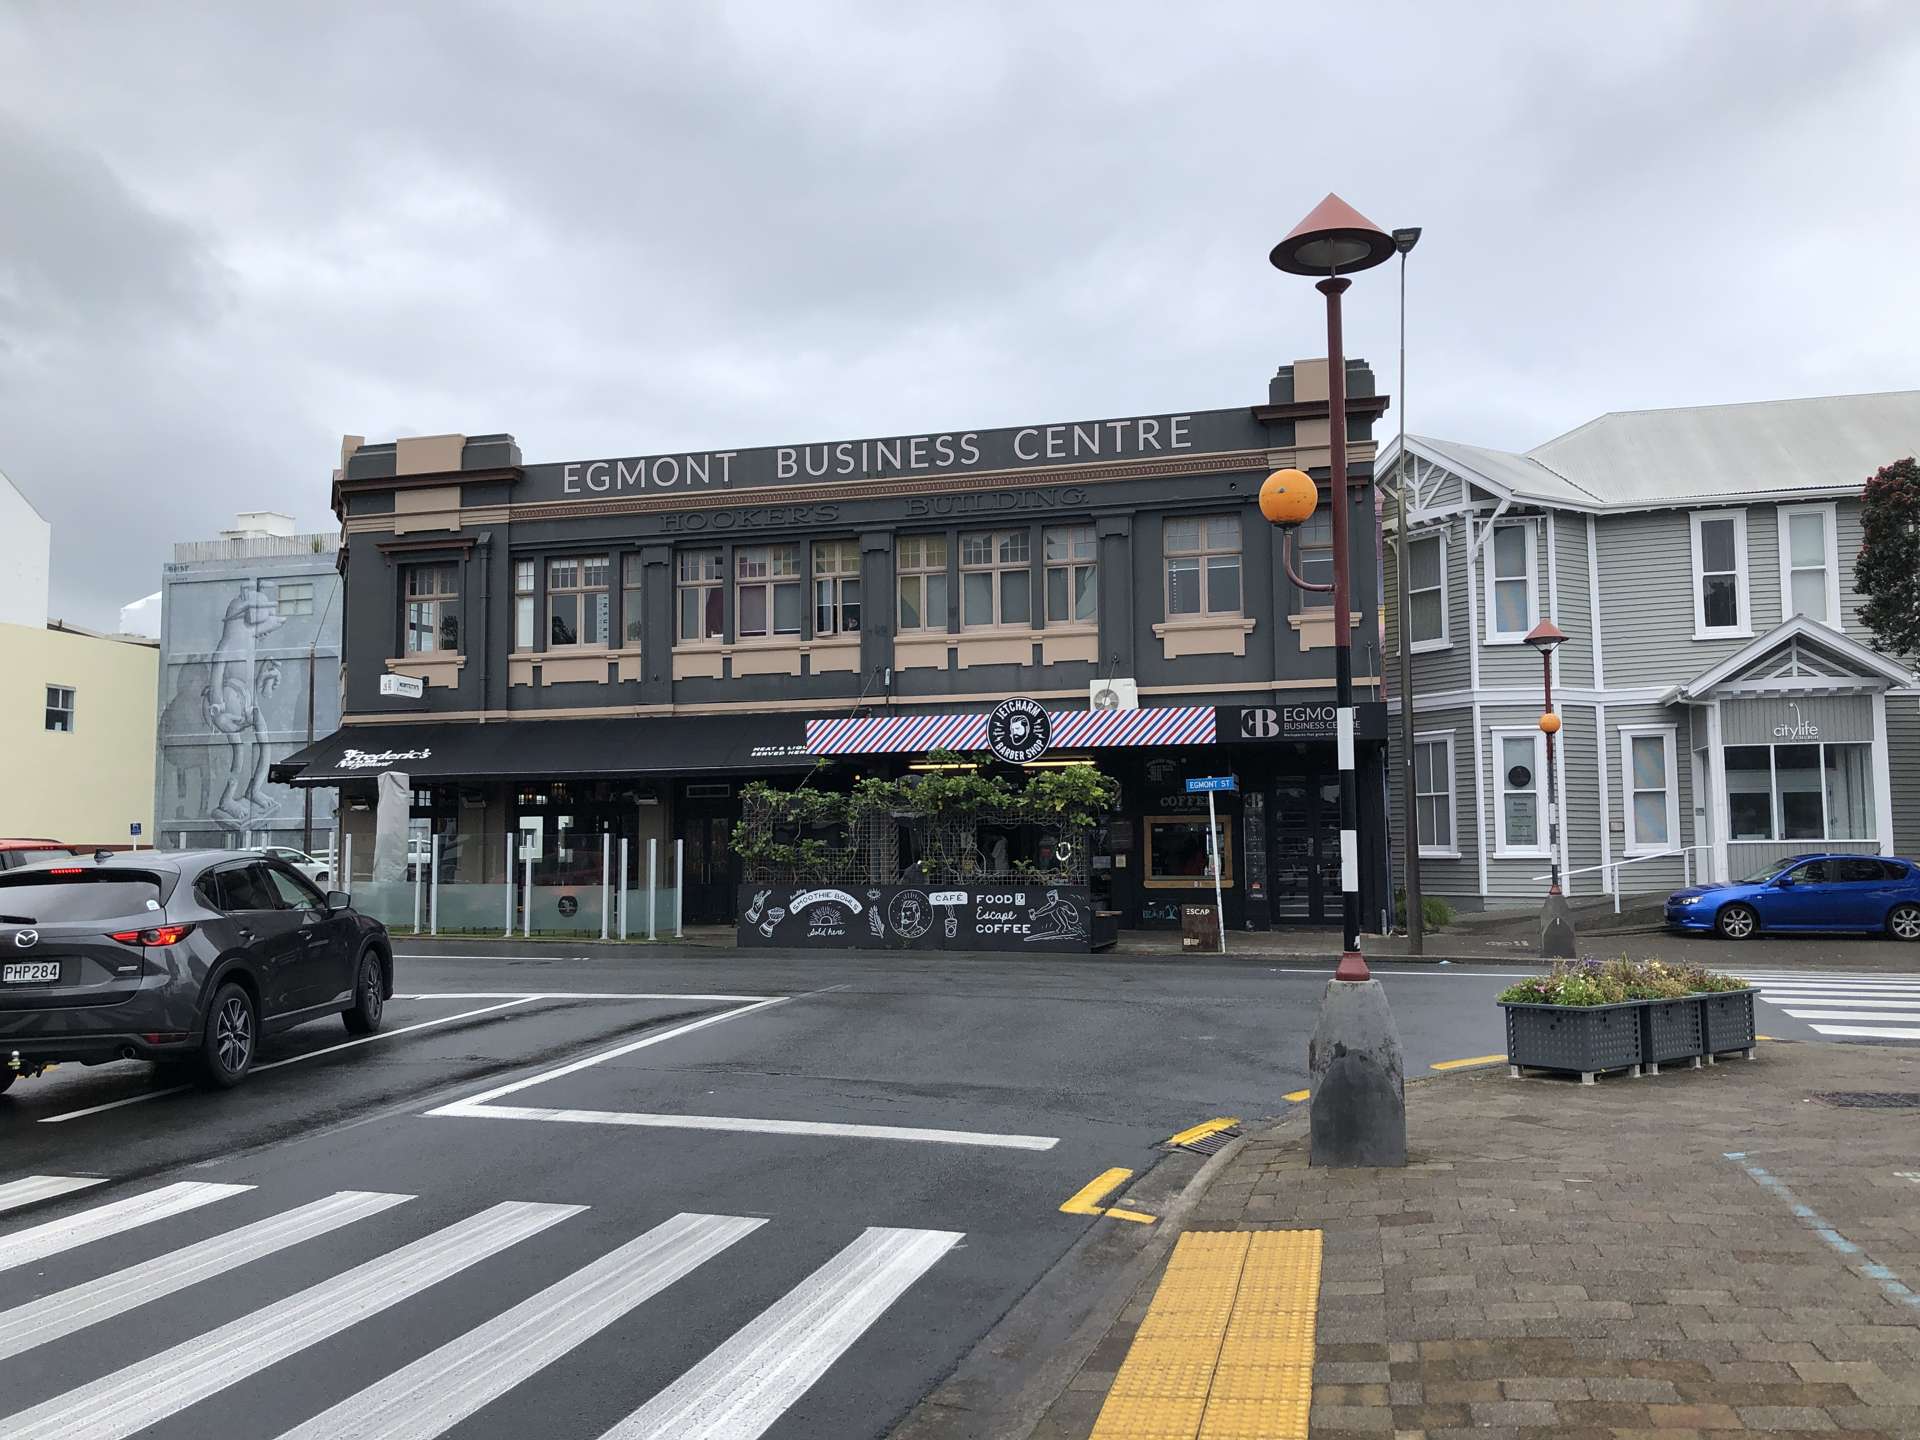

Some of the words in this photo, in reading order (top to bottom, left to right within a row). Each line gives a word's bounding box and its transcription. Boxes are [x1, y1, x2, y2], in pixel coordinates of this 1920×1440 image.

[564, 452, 737, 493] EGMONT
[777, 433, 980, 479] BUSINESS
[1014, 416, 1192, 460] CENTRE
[660, 504, 839, 532] HOOKER'S
[996, 700, 1041, 720] JETCHARM
[1283, 706, 1360, 721] EGMOT
[1284, 721, 1325, 730] BUSINESS
[1326, 720, 1360, 729] CEE
[1773, 714, 1818, 740] citylife
[995, 742, 1025, 760] BARBER
[1026, 739, 1044, 758] SHOP
[1189, 780, 1218, 789] EGMONT
[792, 891, 833, 911] SMOOTHIE
[834, 892, 859, 911] BOWLS
[935, 894, 963, 902] CAFÉ
[976, 894, 1013, 904] FOOD
[975, 906, 1017, 923] Escape
[827, 928, 846, 936] here
[975, 924, 1031, 934] COFFEE
[4, 964, 58, 979] PHP284
